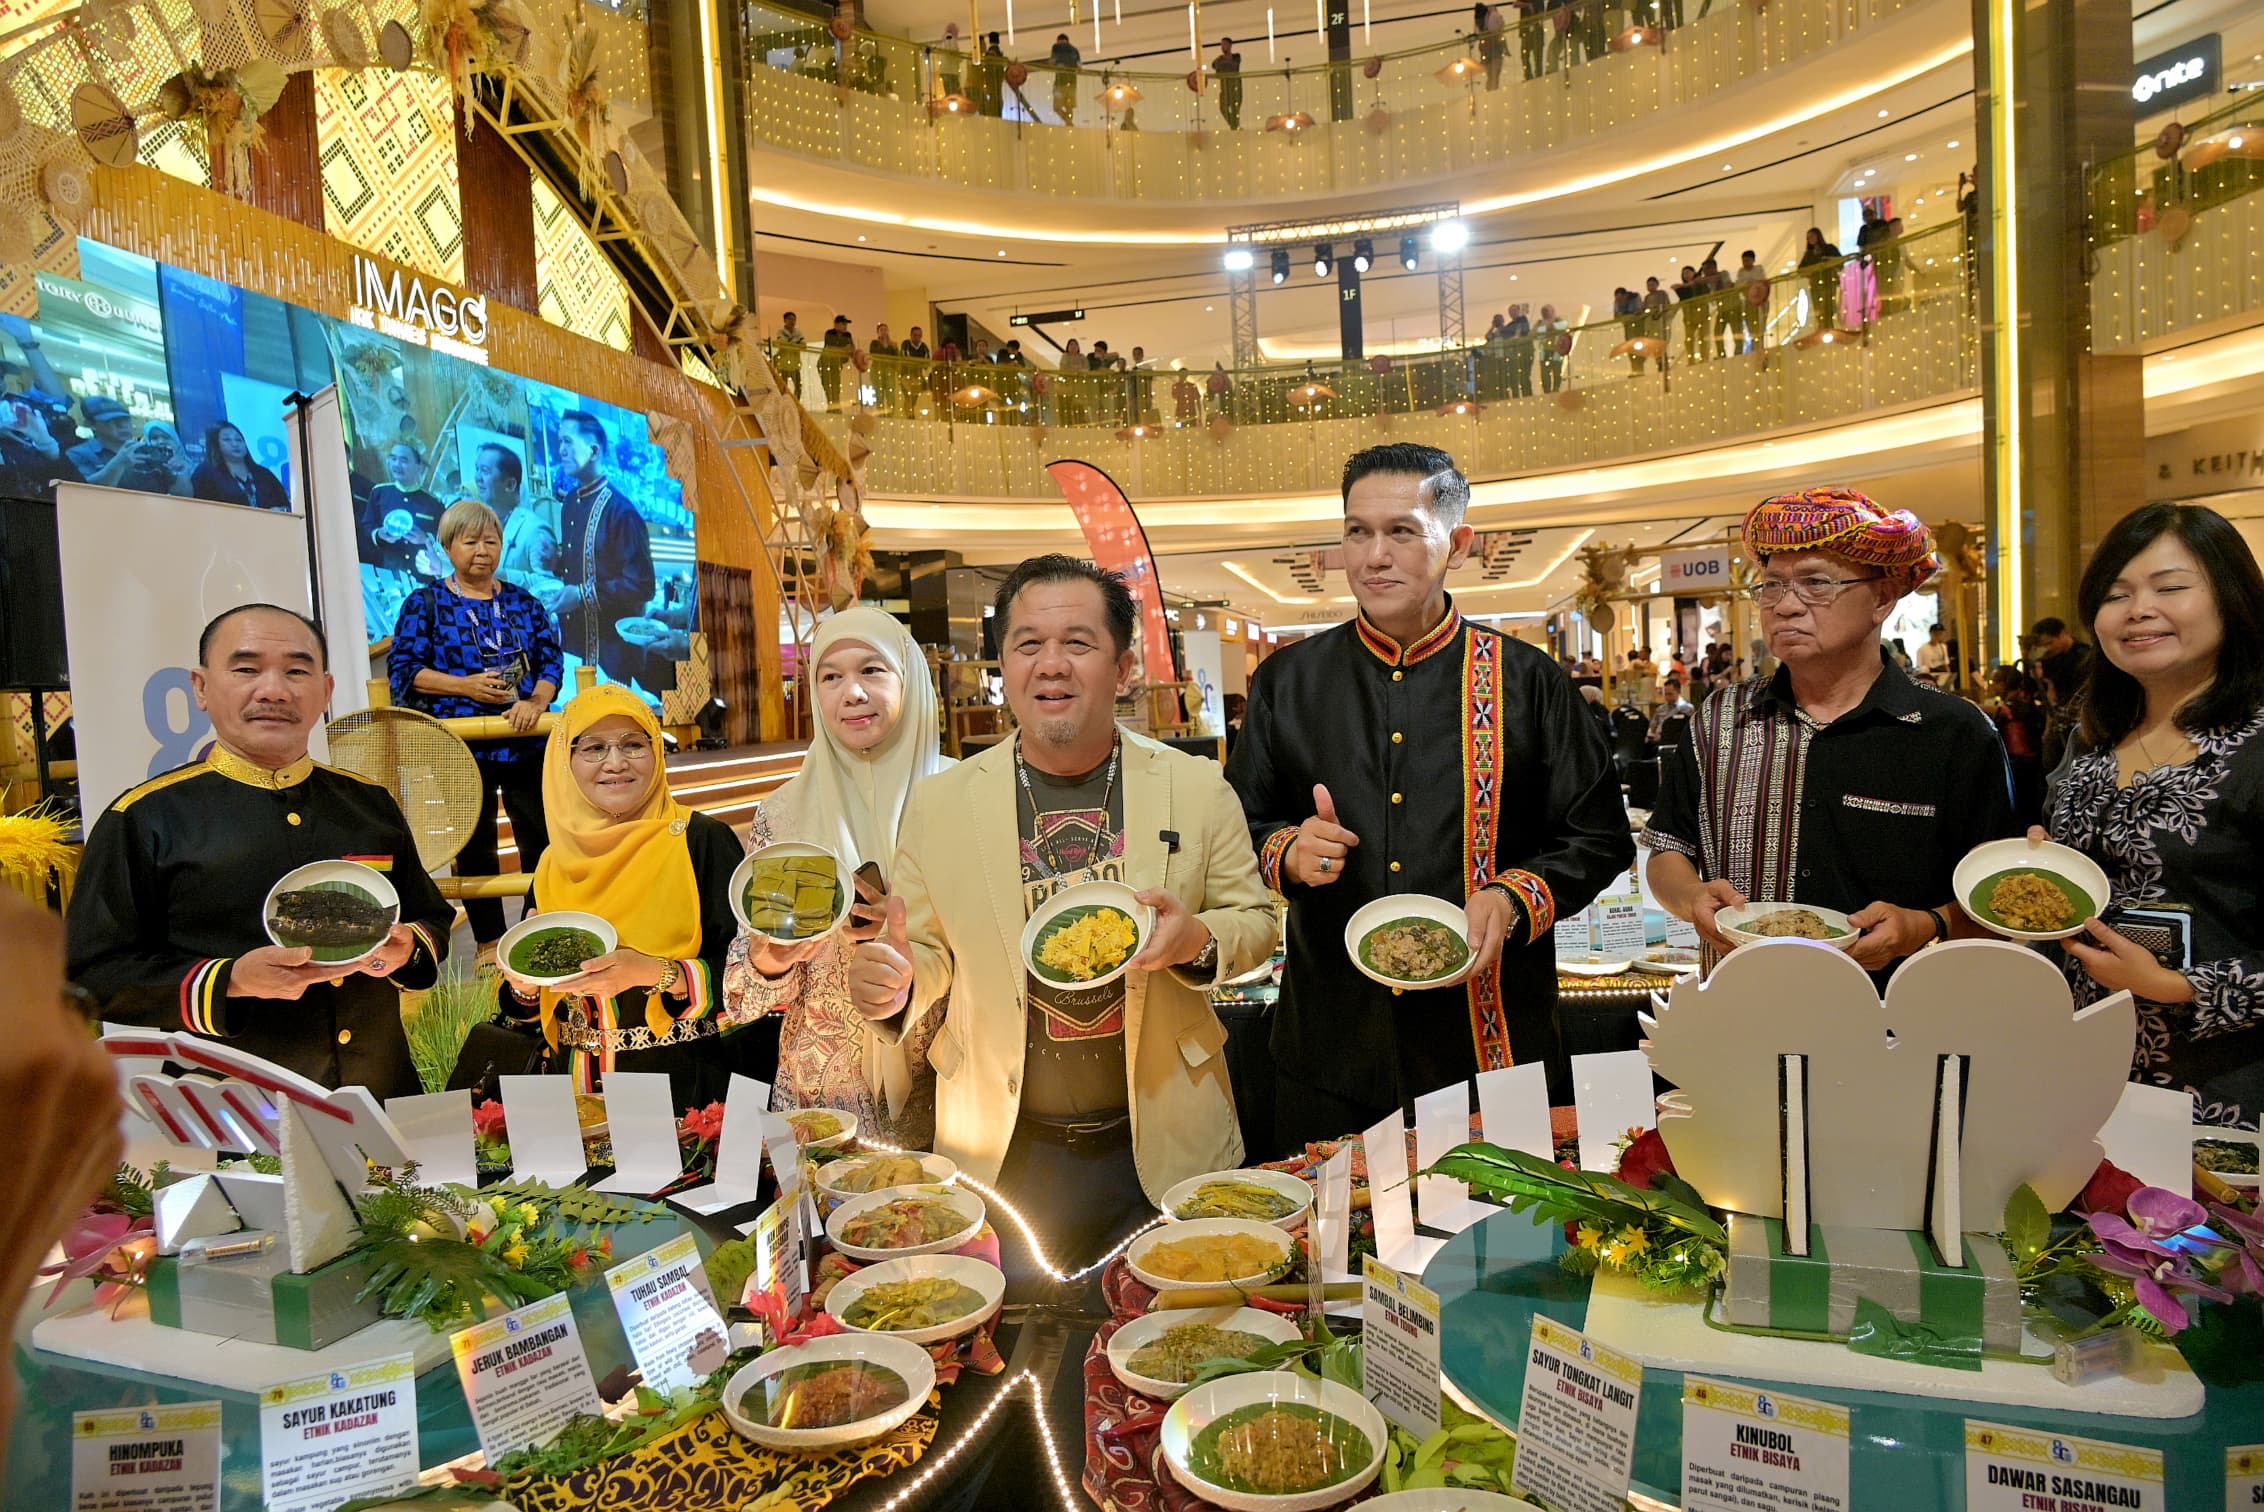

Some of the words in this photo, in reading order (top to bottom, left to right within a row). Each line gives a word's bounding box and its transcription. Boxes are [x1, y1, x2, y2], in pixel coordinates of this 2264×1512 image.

[1331, 12, 1344, 25] 2F
[355, 254, 487, 344] IMAGO
[1344, 289, 1356, 300] 1F
[2194, 450, 2264, 476] KEITH
[1683, 560, 1720, 576] UOB
[1054, 986, 1113, 1005] Brussels
[630, 1278, 657, 1302] TUHAU
[658, 1265, 690, 1290] SAMBAL
[643, 1297, 661, 1311] ETNIK
[660, 1282, 687, 1302] KADAZAN
[1370, 1286, 1396, 1312] SAMBAL
[1398, 1302, 1434, 1336] BELIMBING
[1385, 1310, 1399, 1327] ETNIK
[472, 1349, 504, 1374] JERUK
[506, 1323, 568, 1360] BAMBANGAN
[495, 1361, 518, 1378] ETNIK
[520, 1346, 553, 1369] KADAZAN
[1532, 1349, 1560, 1374] SAYUR
[1563, 1362, 1601, 1393] TONGKAT
[1603, 1382, 1634, 1409] LANGIT
[1557, 1380, 1576, 1398] ETNIK
[1578, 1389, 1603, 1412] BISAYA
[1696, 1389, 1706, 1399] 46
[283, 1406, 325, 1429] SAYUR
[331, 1390, 396, 1419] KAKATUNG
[304, 1424, 331, 1440] ETNIK
[334, 1413, 378, 1434] KADAZAN
[1737, 1424, 1794, 1453] KINUBOL
[1981, 1435, 1992, 1445] 47
[110, 1440, 184, 1461] HINOMPUKA
[294, 1449, 328, 1463] kampung
[331, 1444, 349, 1454] yang
[384, 1429, 410, 1442] dengan
[1730, 1443, 1760, 1461] ETNIK
[1762, 1450, 1800, 1471] BISAYA
[110, 1462, 136, 1476] ETNIK
[140, 1458, 182, 1473] KADAZAN
[1688, 1475, 1712, 1485] masak
[1715, 1481, 1733, 1491] yang
[1688, 1486, 1707, 1497] parut
[1741, 1497, 1755, 1506] dan
[1689, 1463, 1725, 1478] Diperbuat
[1730, 1473, 1763, 1487] daripada
[1769, 1482, 1808, 1498] campuran
[1813, 1492, 1840, 1506] pisang
[1988, 1465, 2046, 1493] DAWAR
[2052, 1476, 2141, 1508] SASANGAU
[2022, 1493, 2056, 1512] ETNIK
